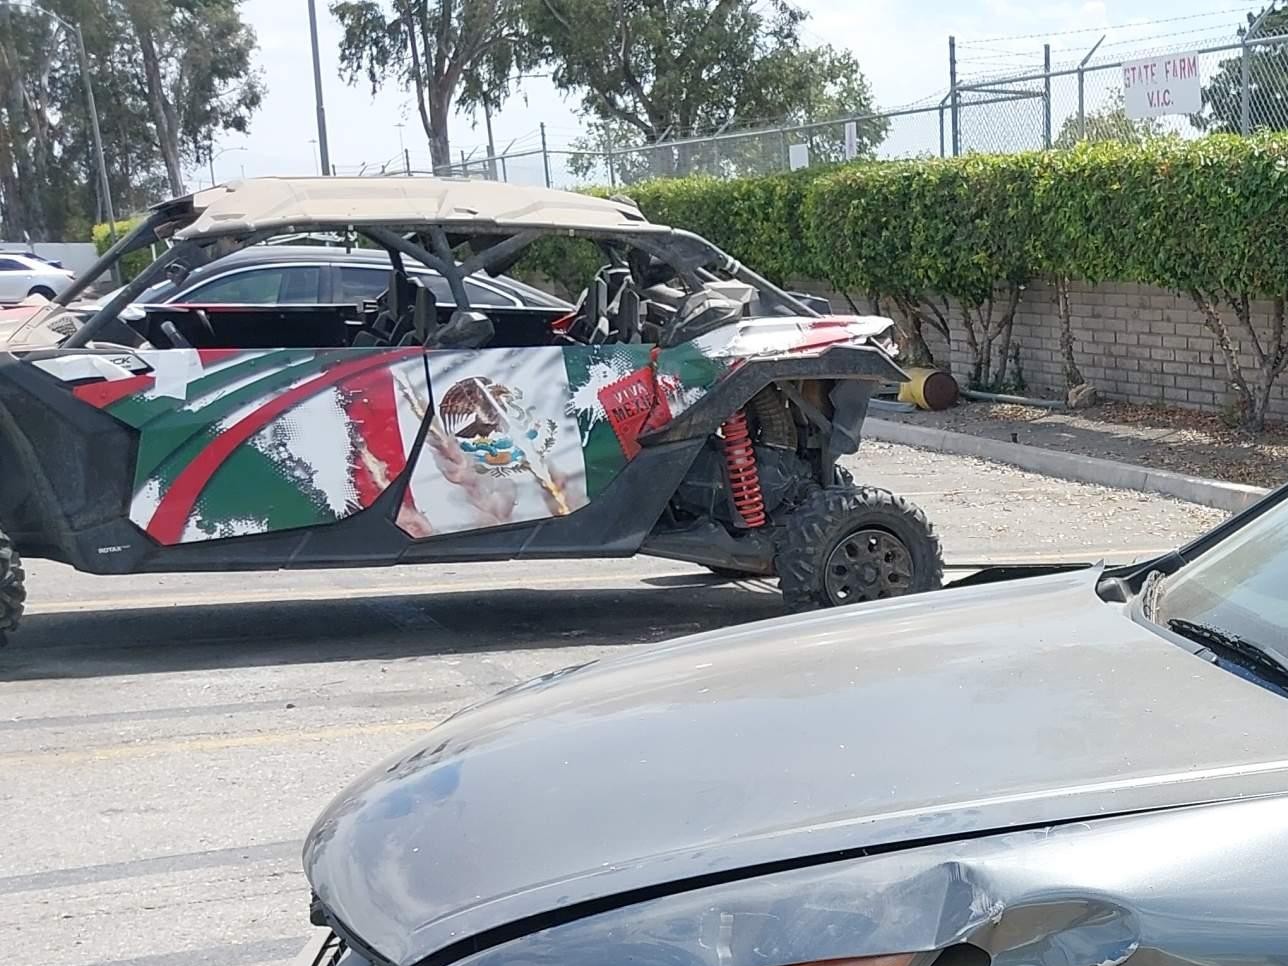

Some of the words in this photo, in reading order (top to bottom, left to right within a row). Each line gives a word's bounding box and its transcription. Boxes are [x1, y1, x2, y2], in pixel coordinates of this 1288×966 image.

[1123, 63, 1157, 88] STATE
[1164, 56, 1197, 82] FARM
[1146, 88, 1174, 108] V.I.C.
[614, 381, 648, 404] VIVA
